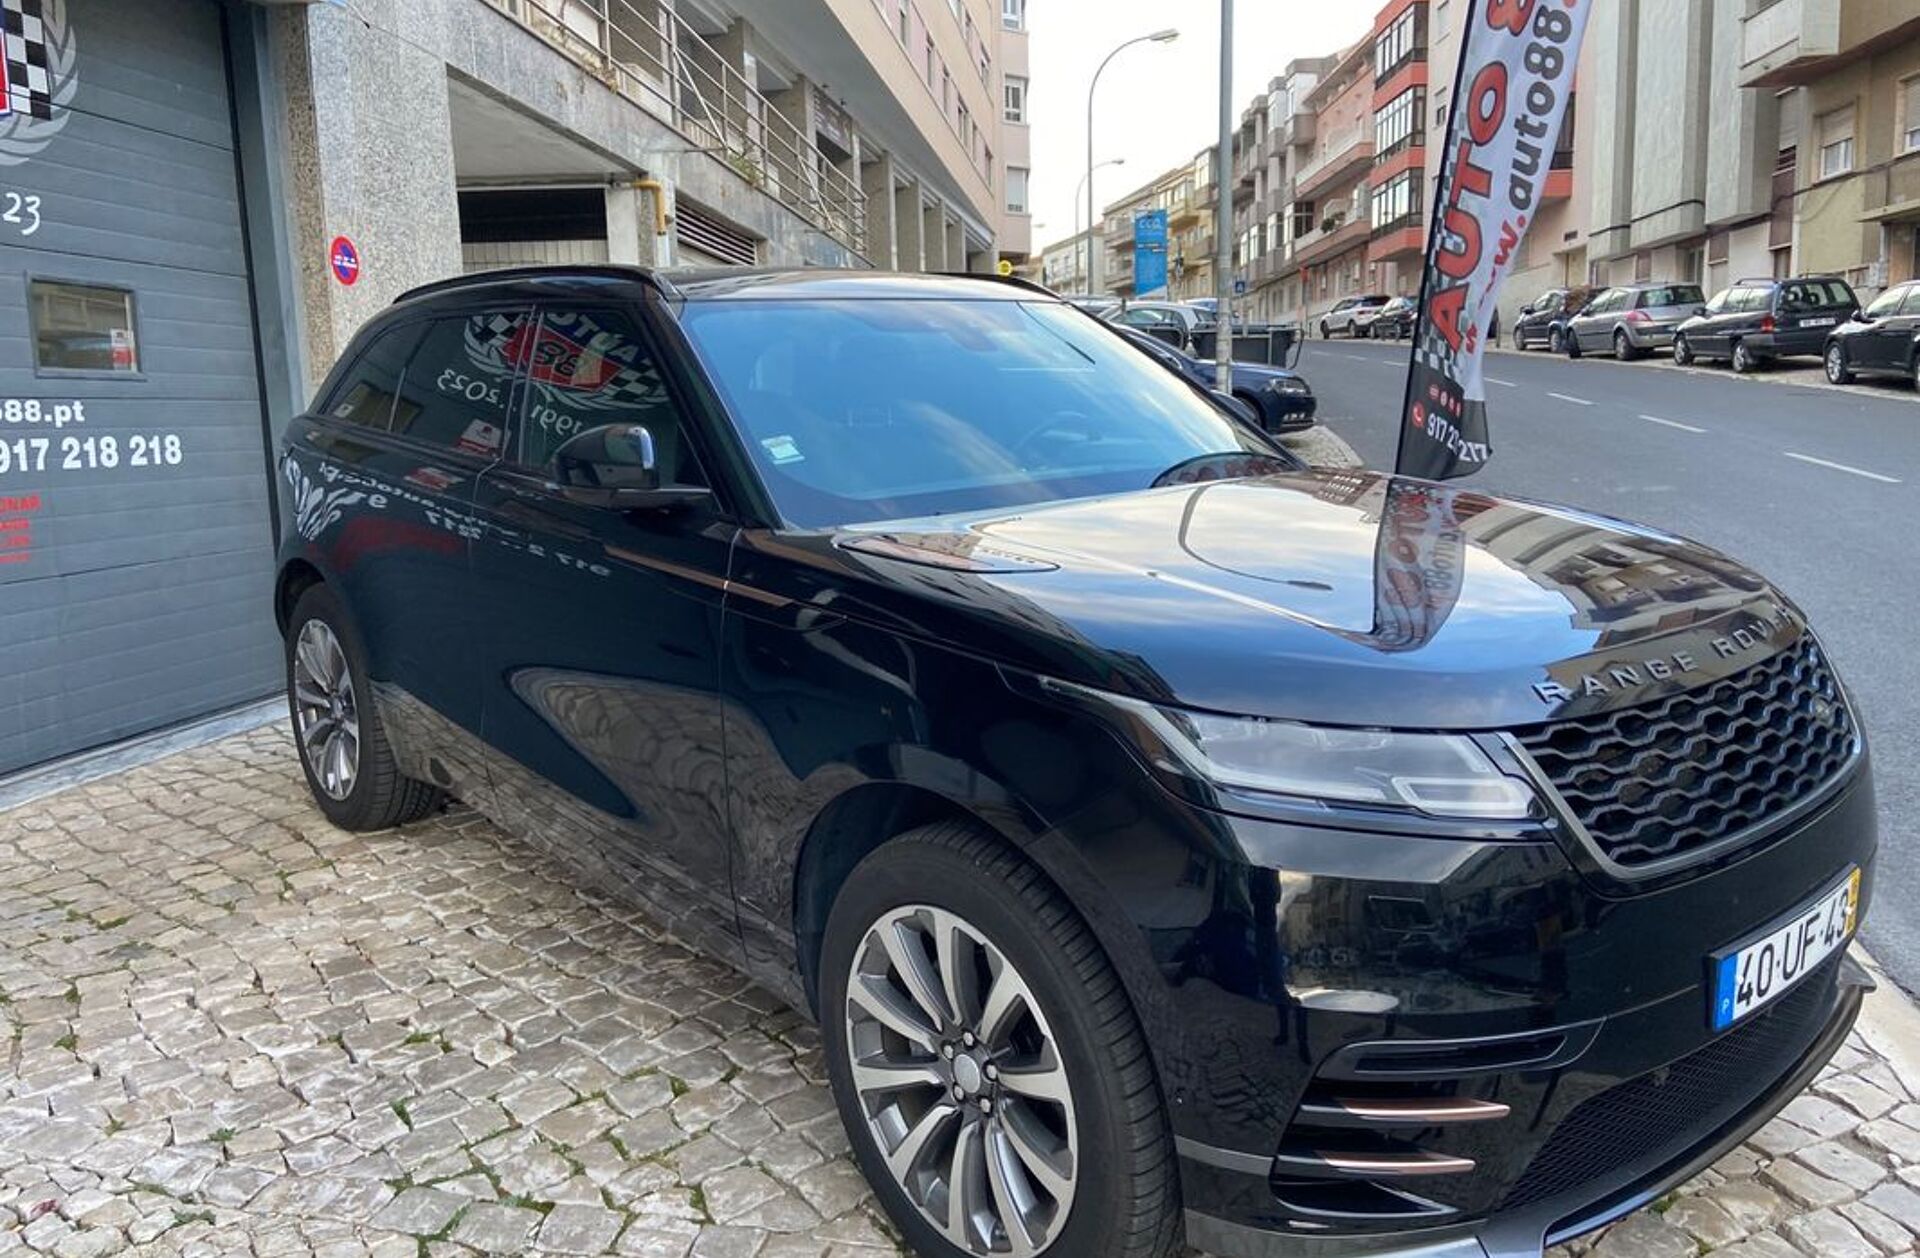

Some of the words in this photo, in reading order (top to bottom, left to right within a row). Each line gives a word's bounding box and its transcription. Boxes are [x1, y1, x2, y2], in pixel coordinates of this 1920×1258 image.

[1430, 60, 1508, 355] AUTO
[0, 399, 86, 428] 88.pt
[61, 435, 119, 470] 218
[129, 434, 183, 466] 218
[1531, 650, 1699, 705] RANGE
